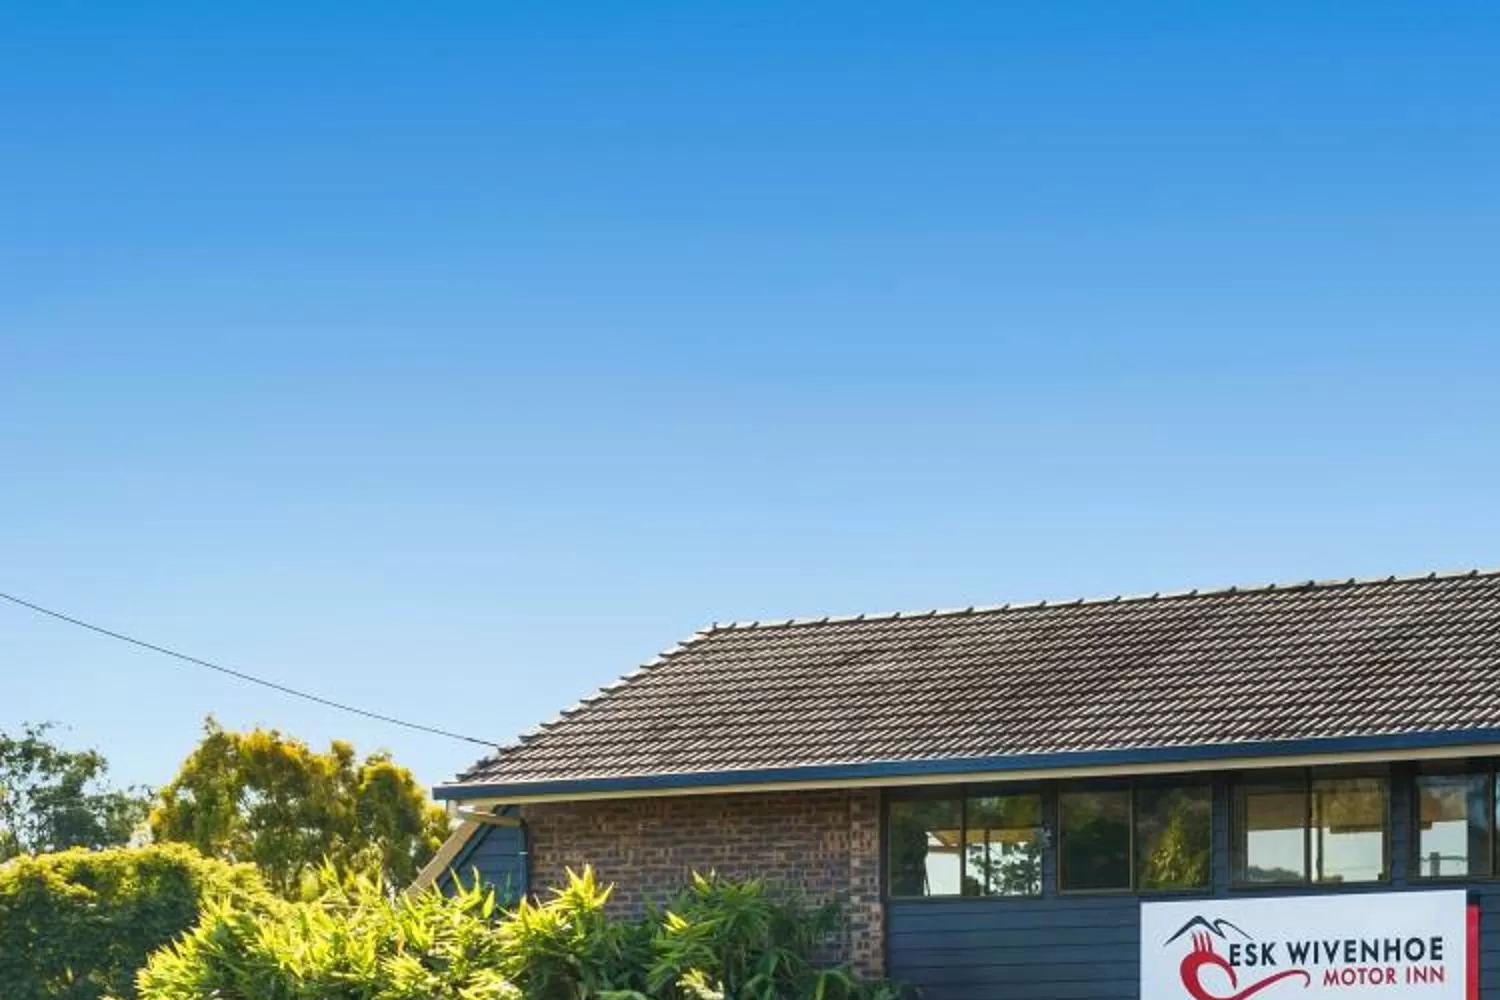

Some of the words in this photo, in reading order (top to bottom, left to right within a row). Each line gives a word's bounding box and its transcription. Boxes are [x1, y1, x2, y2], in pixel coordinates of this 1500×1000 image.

[1229, 943, 1277, 966] ESK
[1287, 937, 1443, 964] WIVENHOE
[1323, 968, 1396, 986] MOTOR
[1406, 967, 1444, 983] INN
